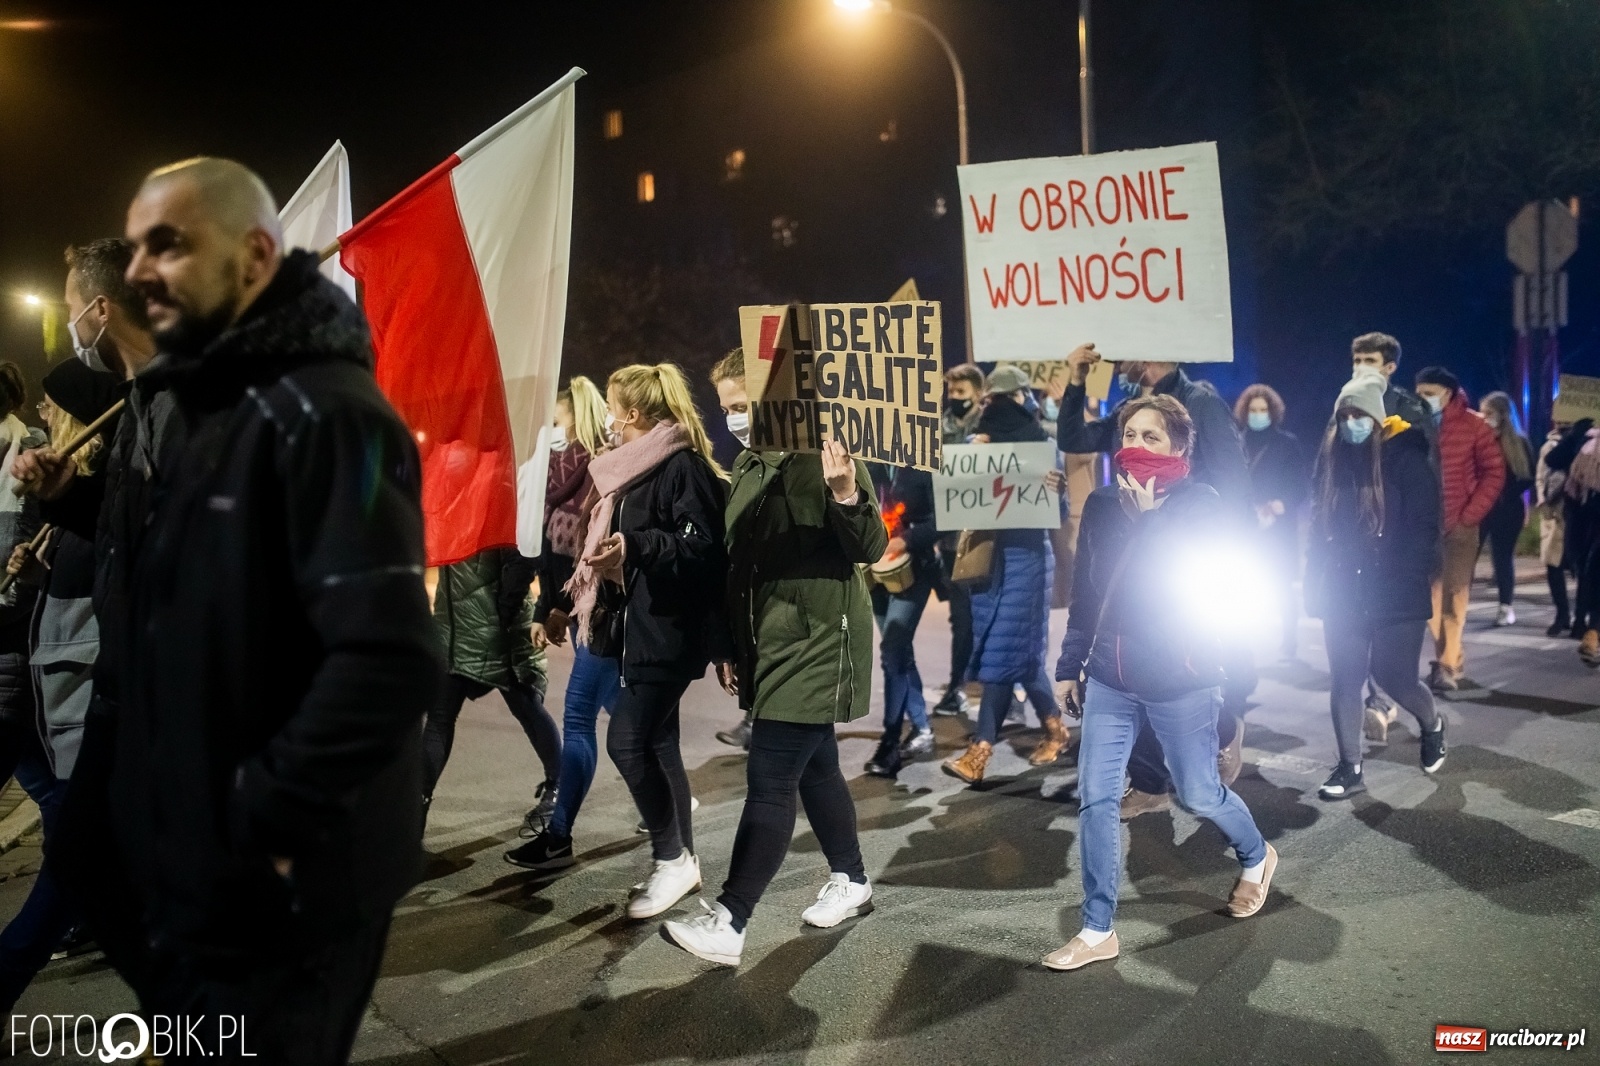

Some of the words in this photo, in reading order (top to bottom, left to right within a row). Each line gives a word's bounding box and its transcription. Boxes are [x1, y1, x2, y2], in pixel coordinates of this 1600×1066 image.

[969, 193, 997, 234] W
[1019, 166, 1189, 232] OBRONIE
[983, 236, 1184, 309] WOLNOŚCI
[751, 400, 940, 468] WYPIERDALAJTE
[940, 452, 1022, 477] WOLNA
